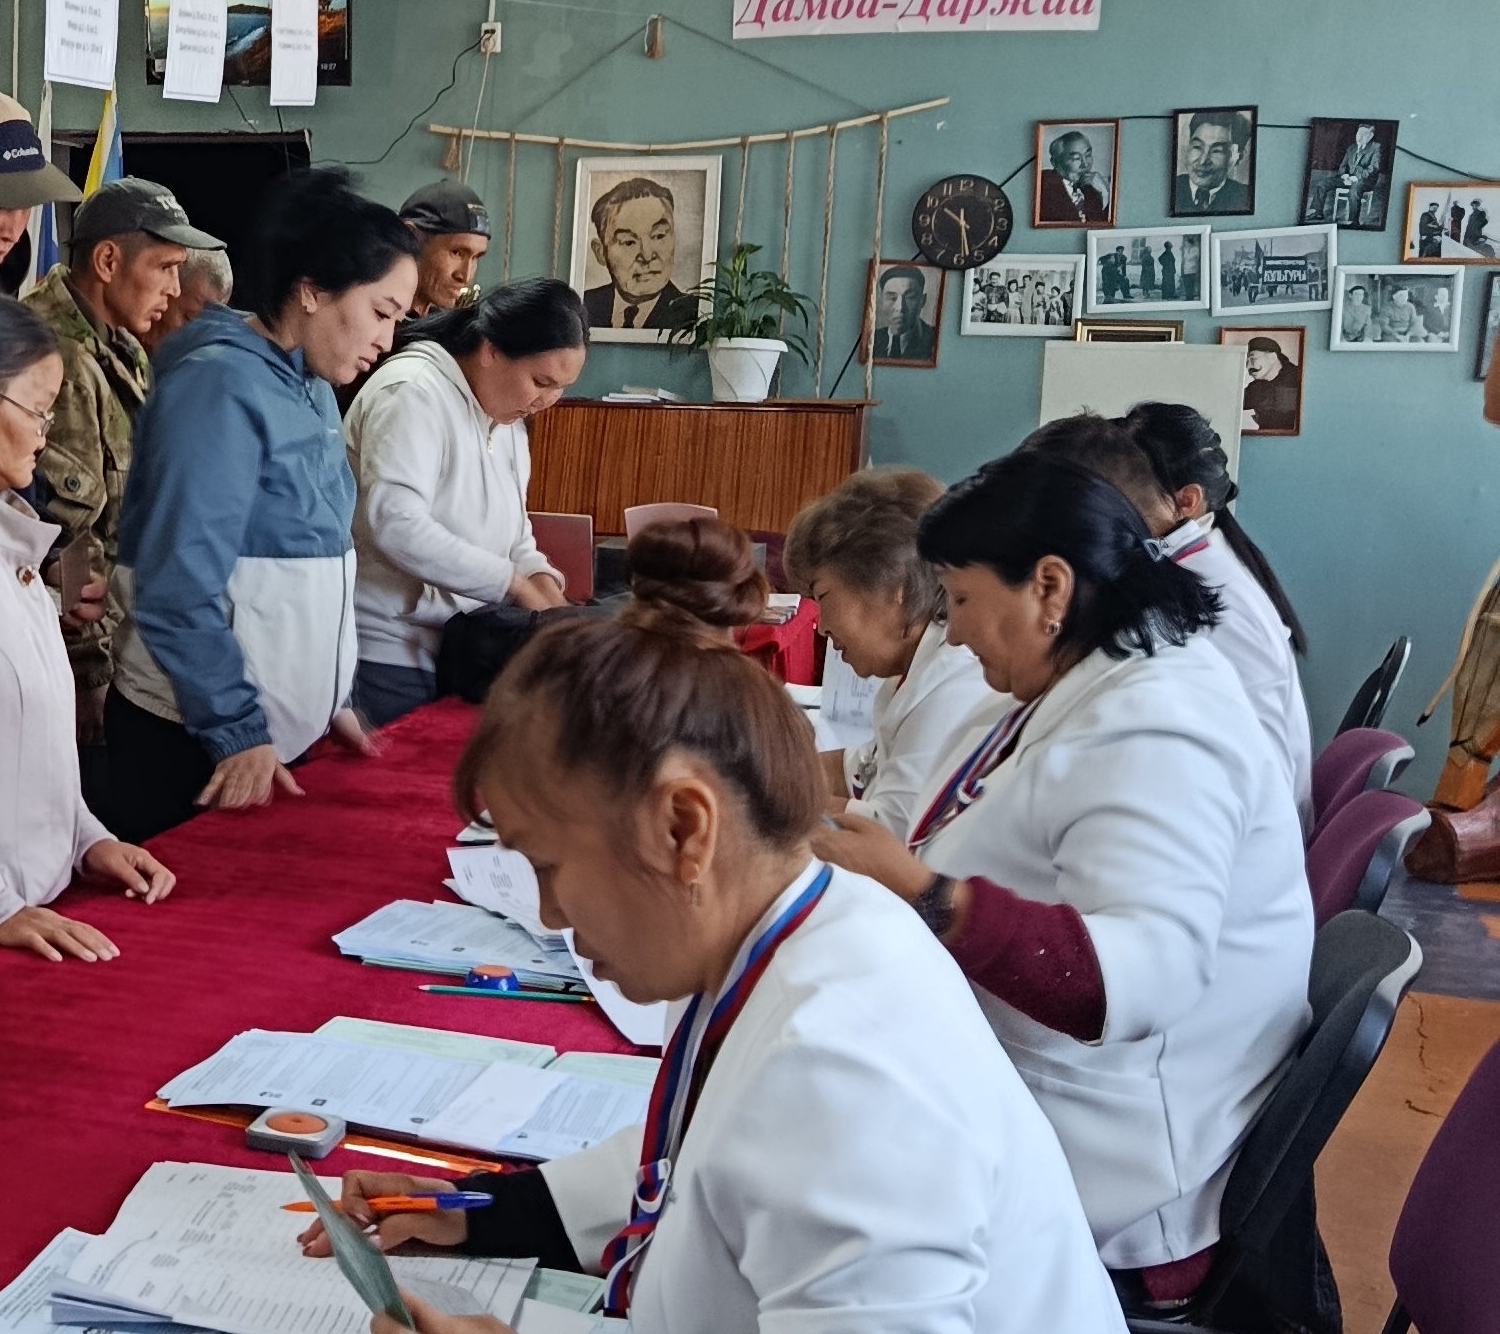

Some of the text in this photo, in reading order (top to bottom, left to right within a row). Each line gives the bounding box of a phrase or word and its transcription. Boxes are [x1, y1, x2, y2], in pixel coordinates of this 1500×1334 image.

[943, 182, 953, 196] 11
[960, 179, 975, 192] 12
[984, 184, 989, 197] 1
[926, 195, 939, 208] 10
[993, 198, 1005, 211] 2
[918, 214, 931, 226] 9
[996, 217, 1008, 231] 3
[921, 232, 933, 246] 8
[988, 235, 999, 247] 4
[936, 248, 947, 261] 7
[953, 252, 965, 265] 6
[973, 249, 985, 262] 5
[1263, 269, 1307, 282] КУЛЬТУРЫ
